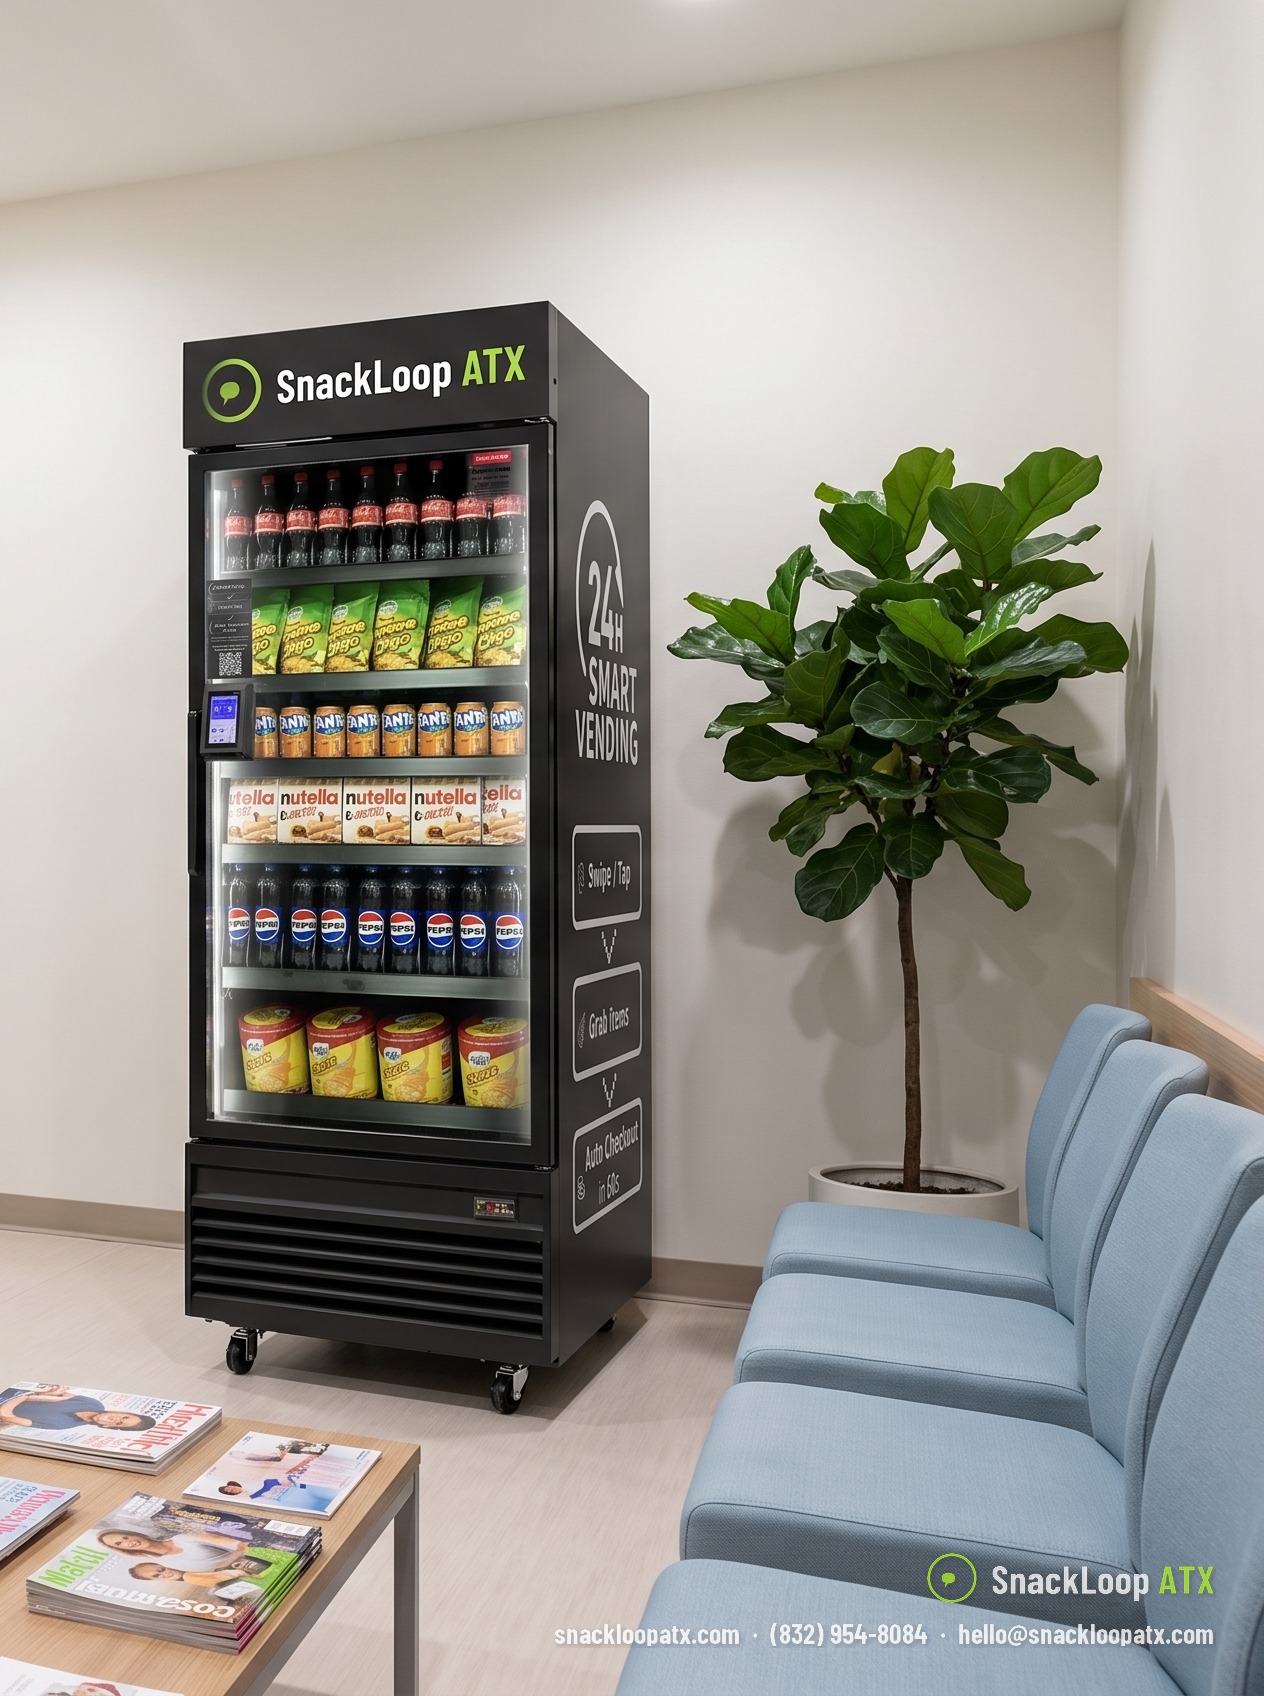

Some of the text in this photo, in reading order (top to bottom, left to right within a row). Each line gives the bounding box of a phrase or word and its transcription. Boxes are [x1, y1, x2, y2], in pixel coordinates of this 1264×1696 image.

[276, 344, 526, 404] SnackLoop ATX
[589, 656, 637, 714] SMART
[575, 709, 638, 766] VENDING
[281, 789, 338, 805] nutella
[345, 788, 406, 805] nutella
[414, 788, 476, 805] nutella
[617, 861, 631, 891] Tap
[588, 1006, 630, 1040] Grab items
[584, 1120, 639, 1173] Auto Checkout
[598, 1180, 606, 1205] in
